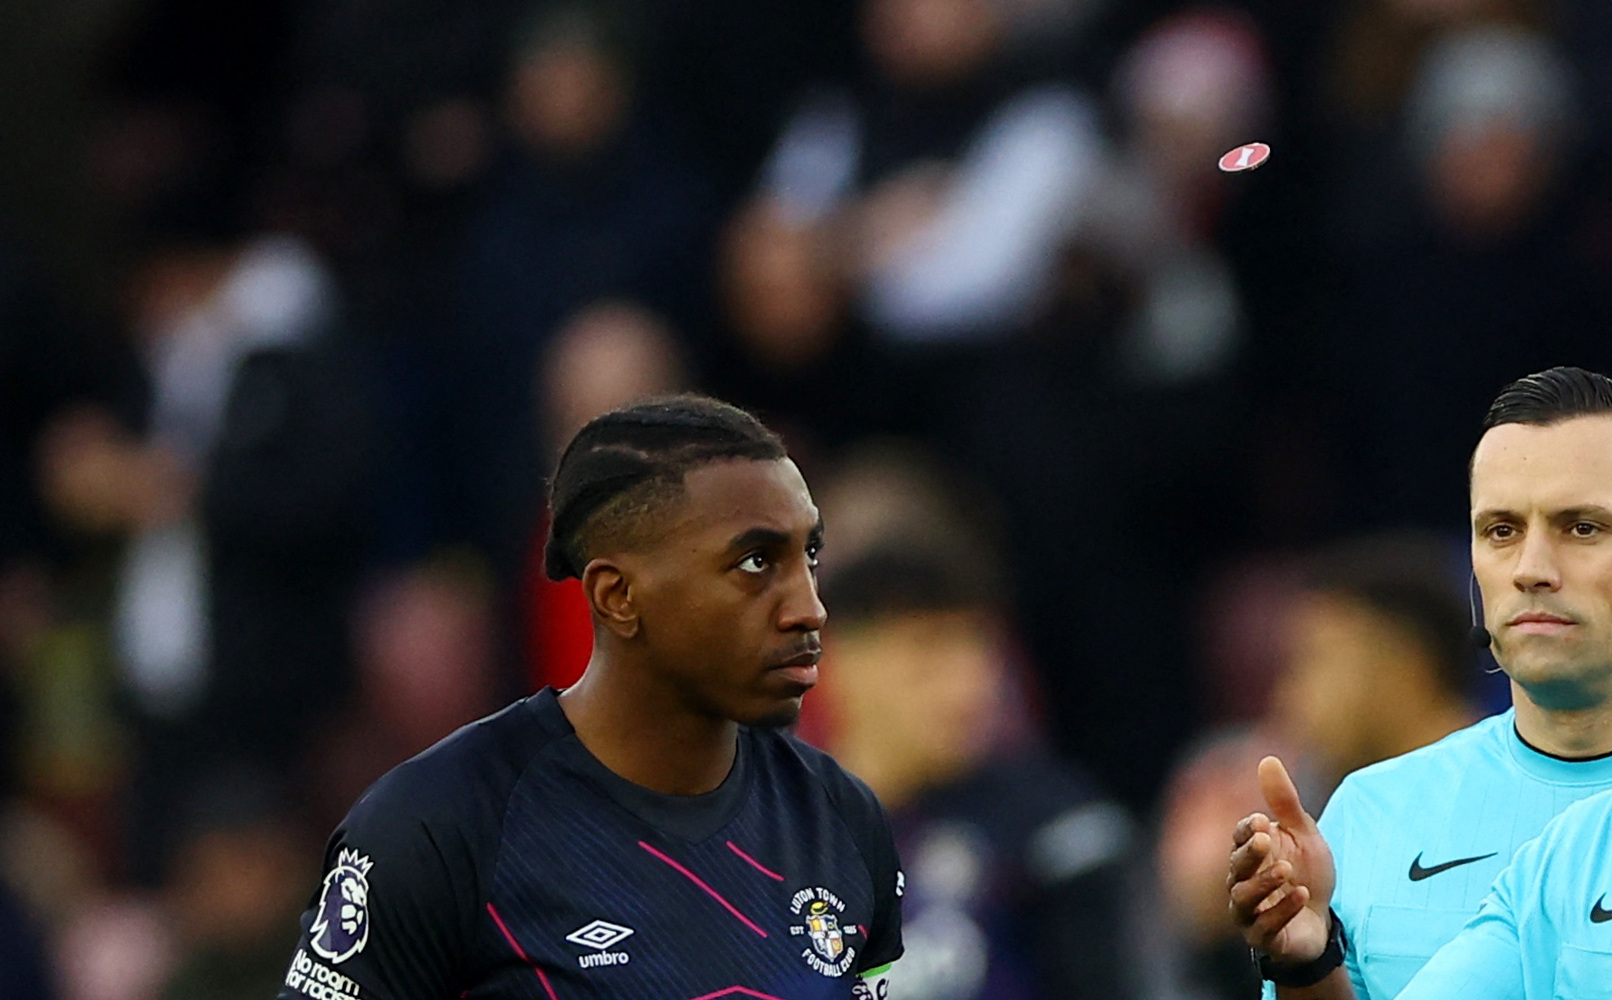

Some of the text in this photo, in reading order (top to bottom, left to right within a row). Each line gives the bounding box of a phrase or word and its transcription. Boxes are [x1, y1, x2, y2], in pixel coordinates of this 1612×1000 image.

[790, 887, 846, 914] LUTON TOWN
[290, 949, 360, 996] No room
[579, 950, 629, 969] umbro
[801, 947, 842, 977] FOOTBALL
[285, 967, 306, 989] for
